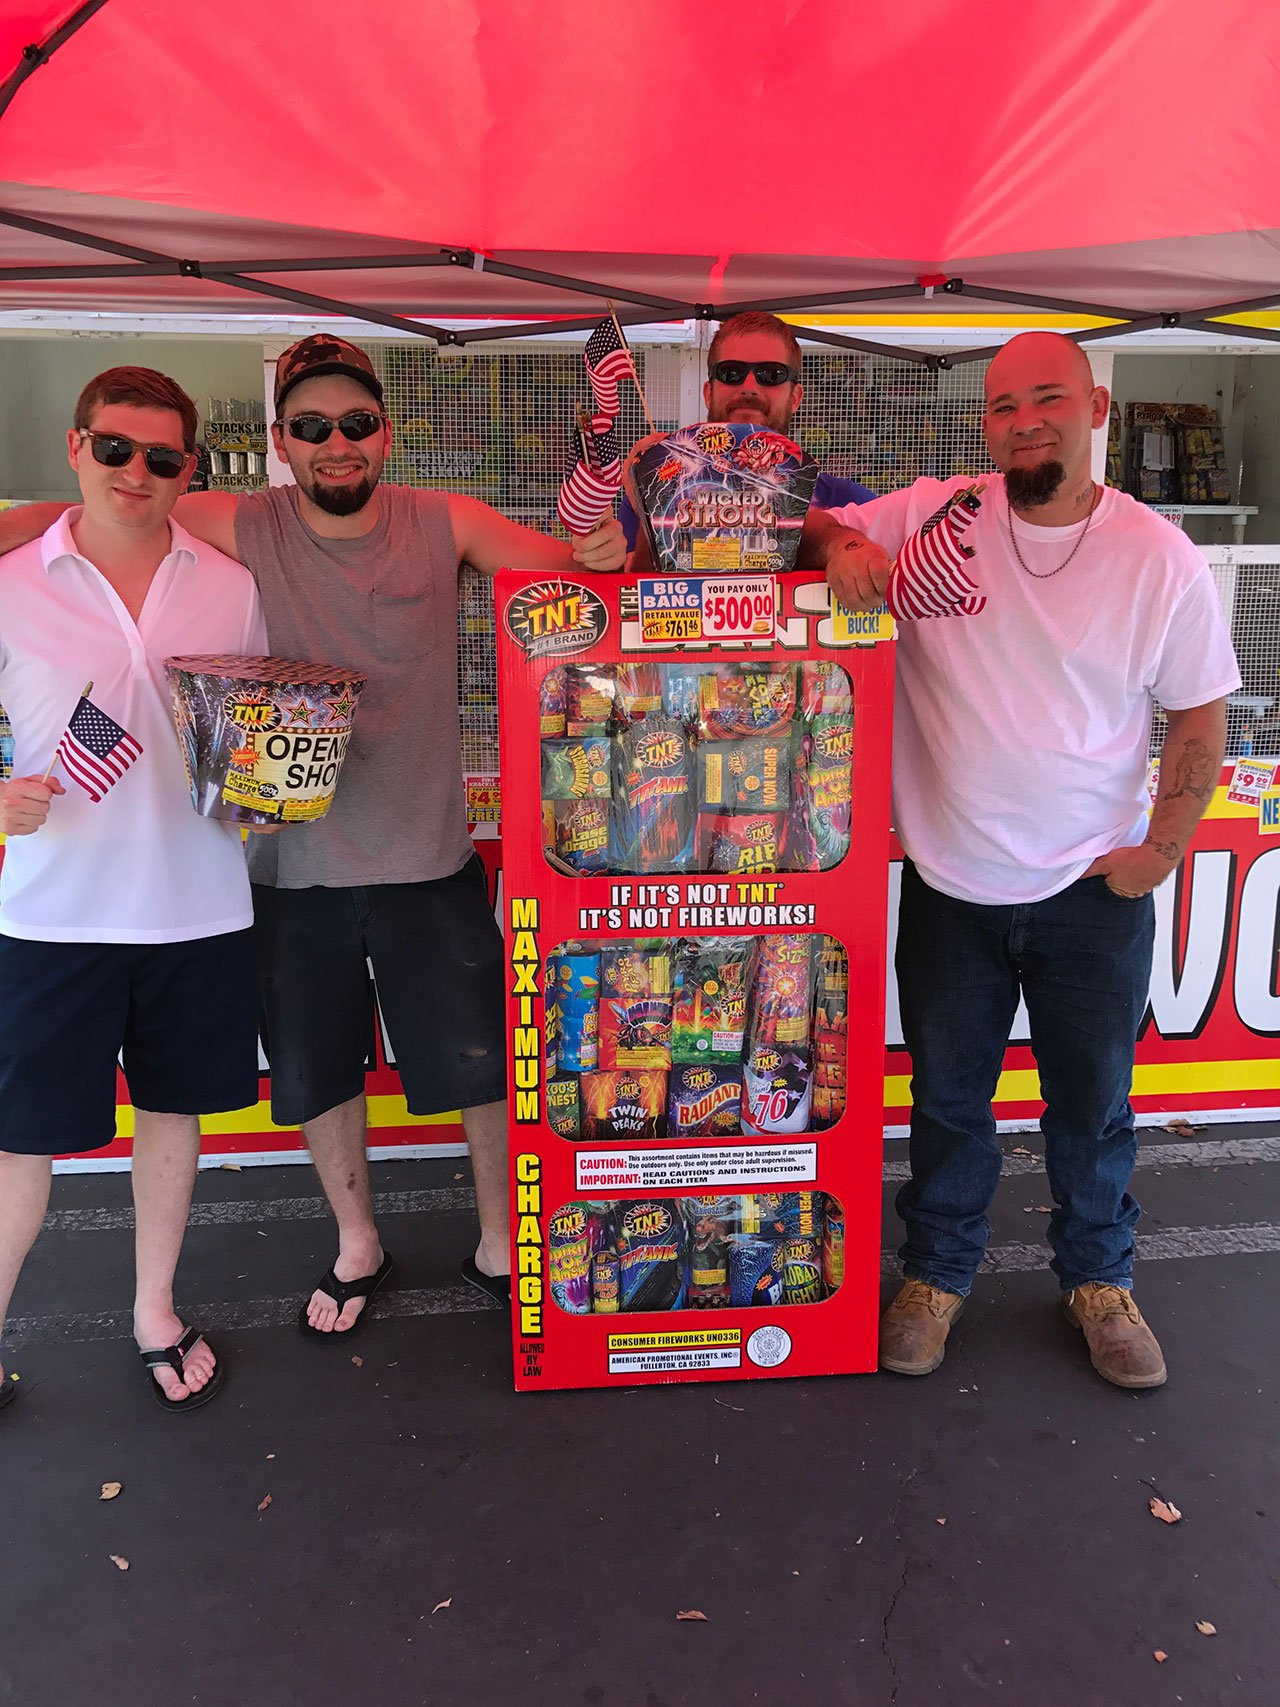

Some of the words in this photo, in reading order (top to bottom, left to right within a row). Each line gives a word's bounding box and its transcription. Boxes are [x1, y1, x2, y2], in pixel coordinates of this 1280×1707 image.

[211, 422, 252, 434] STACKS
[254, 422, 267, 434] UP
[703, 433, 728, 450] TNT
[212, 476, 250, 487] STACKS
[251, 476, 265, 487] UP
[697, 491, 765, 506] WICKED
[677, 498, 776, 528] STRONG
[744, 559, 767, 568] Charge
[653, 582, 689, 595] BIG
[707, 585, 725, 594] YOU
[727, 585, 745, 594] PAY
[746, 584, 768, 593] ONLY
[643, 593, 700, 609] BANG
[528, 595, 582, 637] TNT
[645, 611, 673, 620] RETAIL
[675, 610, 700, 619] VALUE
[847, 615, 880, 634] BUCK!
[536, 640, 550, 650] #1
[554, 632, 594, 646] BRAND
[234, 703, 272, 723] TNT
[646, 738, 674, 762] TNT
[825, 732, 851, 753] TNT
[763, 747, 778, 778] SUPER
[285, 763, 341, 790] SHO
[229, 777, 257, 793] Charge
[763, 780, 777, 806] NOVA
[468, 811, 501, 822] FREE
[580, 811, 598, 826] TNT
[751, 827, 772, 839] TNT
[737, 842, 776, 869] RIP
[611, 885, 632, 907] IF
[638, 884, 681, 906] IT'S
[687, 883, 731, 904] NOT
[579, 908, 622, 930] IT'S
[628, 907, 672, 929] NOT
[678, 904, 816, 929] FIREWORKS!
[755, 1055, 776, 1068] TNT
[688, 1071, 710, 1086] TNT
[620, 1083, 636, 1095] TNT
[548, 1093, 577, 1107] NEST
[678, 1083, 741, 1126] RADIANT
[756, 1089, 788, 1126] 76
[609, 1104, 649, 1119] TWIN
[557, 1120, 573, 1131] TNT
[611, 1117, 645, 1132] PEAKS
[580, 1158, 627, 1170] CAUTION:
[676, 1152, 701, 1160] contains
[701, 1151, 718, 1159] items
[788, 1147, 814, 1155] misused.
[640, 1161, 667, 1169] outdoors
[668, 1160, 683, 1169] only.
[728, 1158, 744, 1166] close
[745, 1157, 761, 1165] adult
[761, 1156, 797, 1165] supervision.
[580, 1173, 641, 1186] IMPORTANT:
[669, 1168, 715, 1178] CAUTIONS
[740, 1165, 806, 1174] INSTRUCTIONS
[686, 1176, 708, 1184] ITEM
[555, 1211, 581, 1233] TNT
[633, 1211, 661, 1232] TNT
[800, 1214, 813, 1236] NOVA
[516, 1153, 543, 1335] CHARGE
[790, 1246, 808, 1260] TNT
[783, 1266, 818, 1287] LOBAL
[611, 1336, 656, 1347] CONSUMER
[658, 1334, 705, 1345] FIREWORKS
[520, 1343, 545, 1354] ALLOWED
[527, 1354, 538, 1365] BY
[611, 1355, 646, 1364] AMERICAN
[647, 1354, 693, 1363] PROMOTIONAL
[678, 1361, 687, 1369] CA
[688, 1360, 711, 1368] 92833
[523, 1366, 542, 1376] LAW
